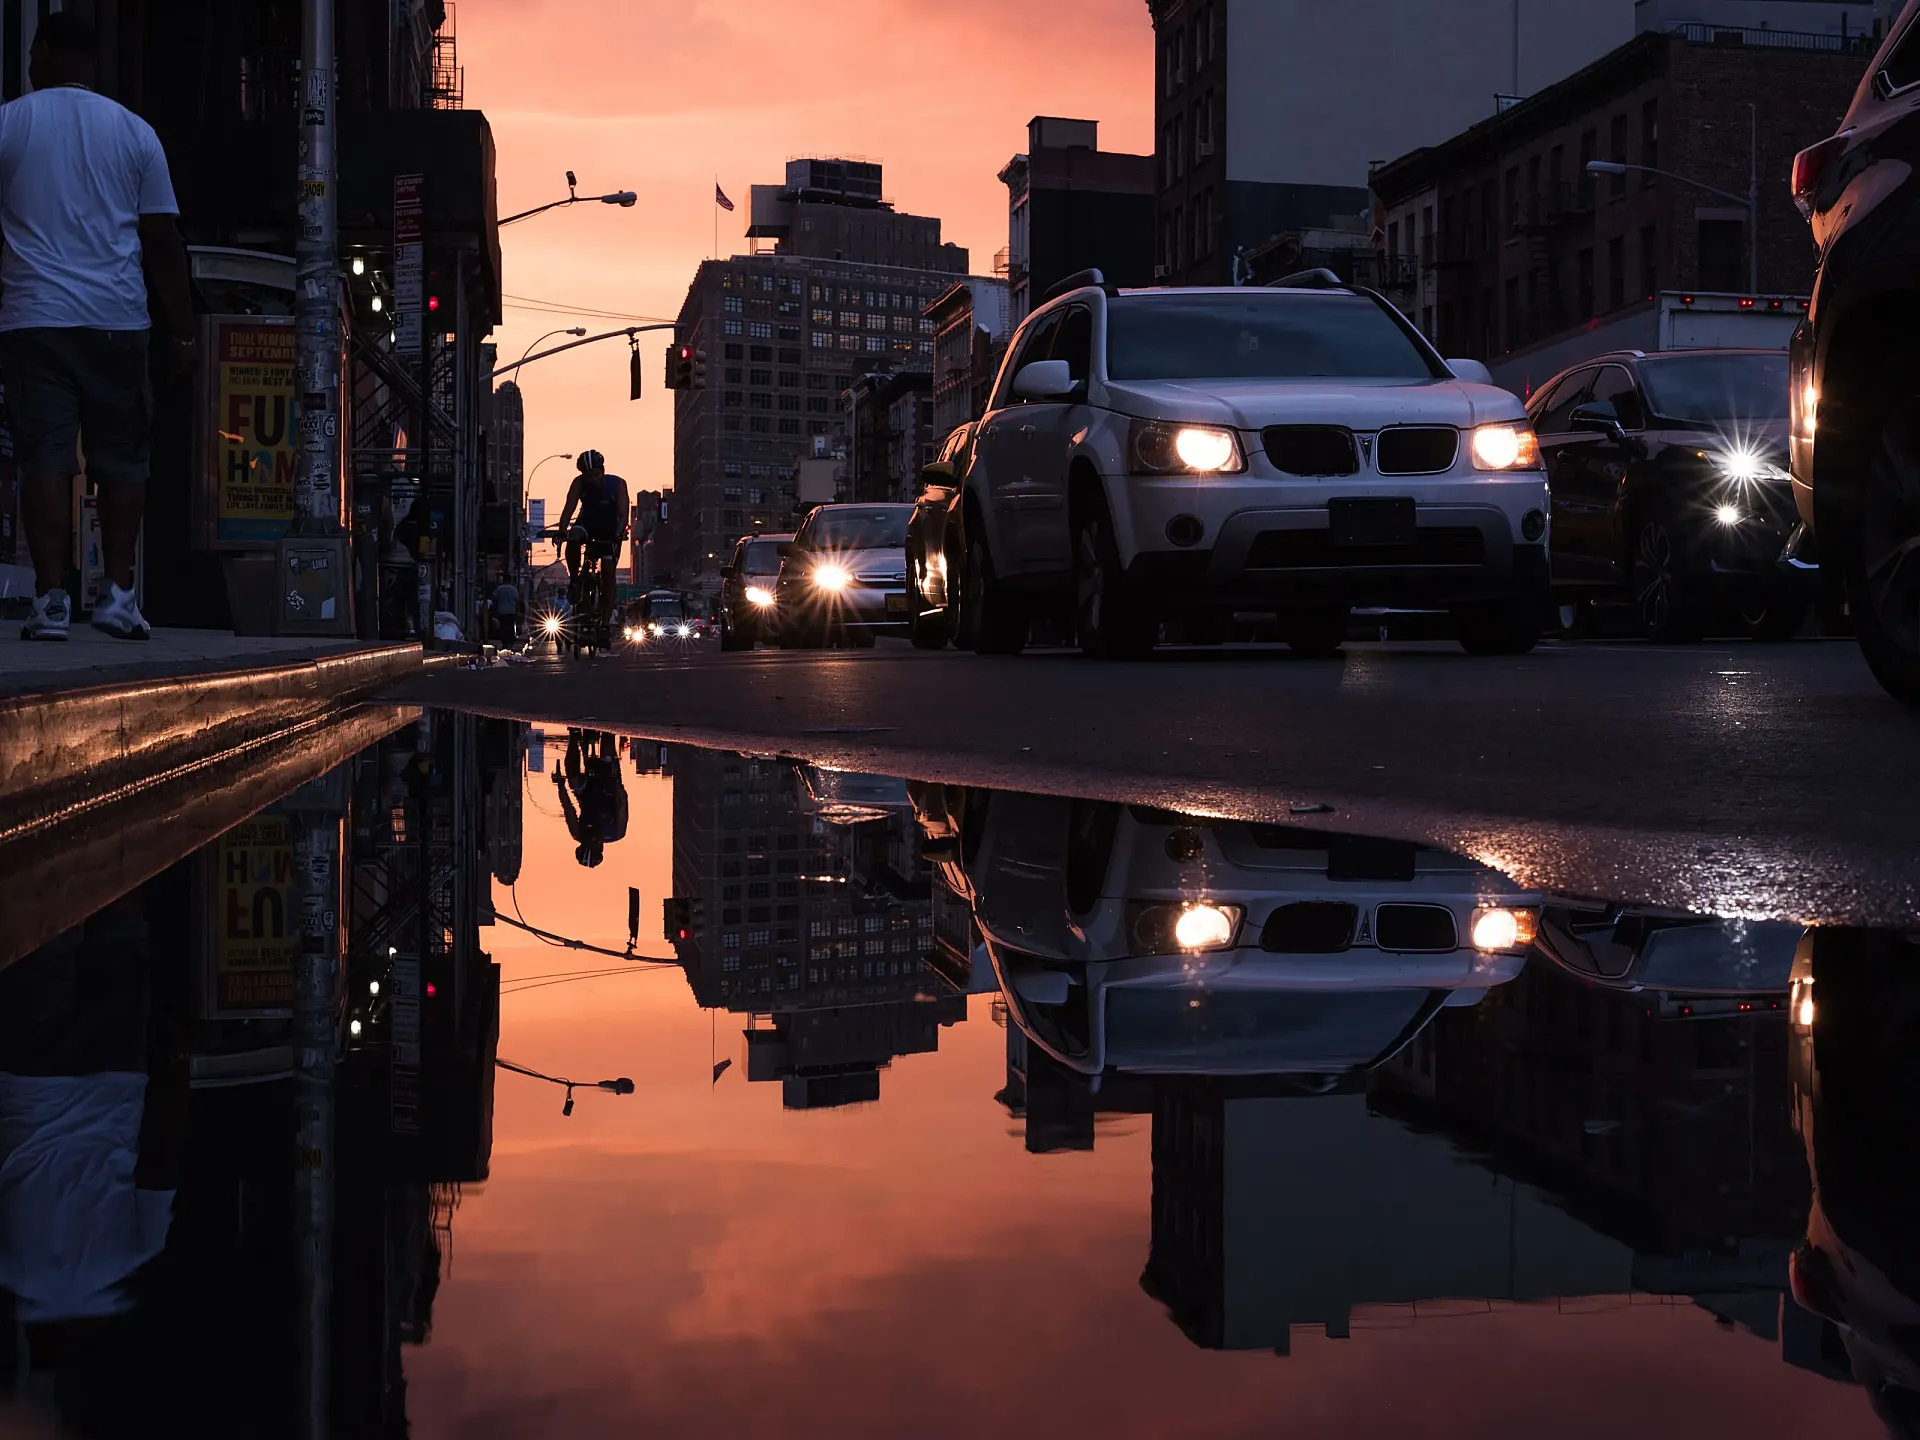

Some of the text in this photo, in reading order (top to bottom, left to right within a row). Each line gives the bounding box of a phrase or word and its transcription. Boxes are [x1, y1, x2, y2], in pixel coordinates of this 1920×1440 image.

[304, 184, 325, 196] ABOVE
[230, 332, 255, 346] FINAL
[263, 377, 282, 386] BEST
